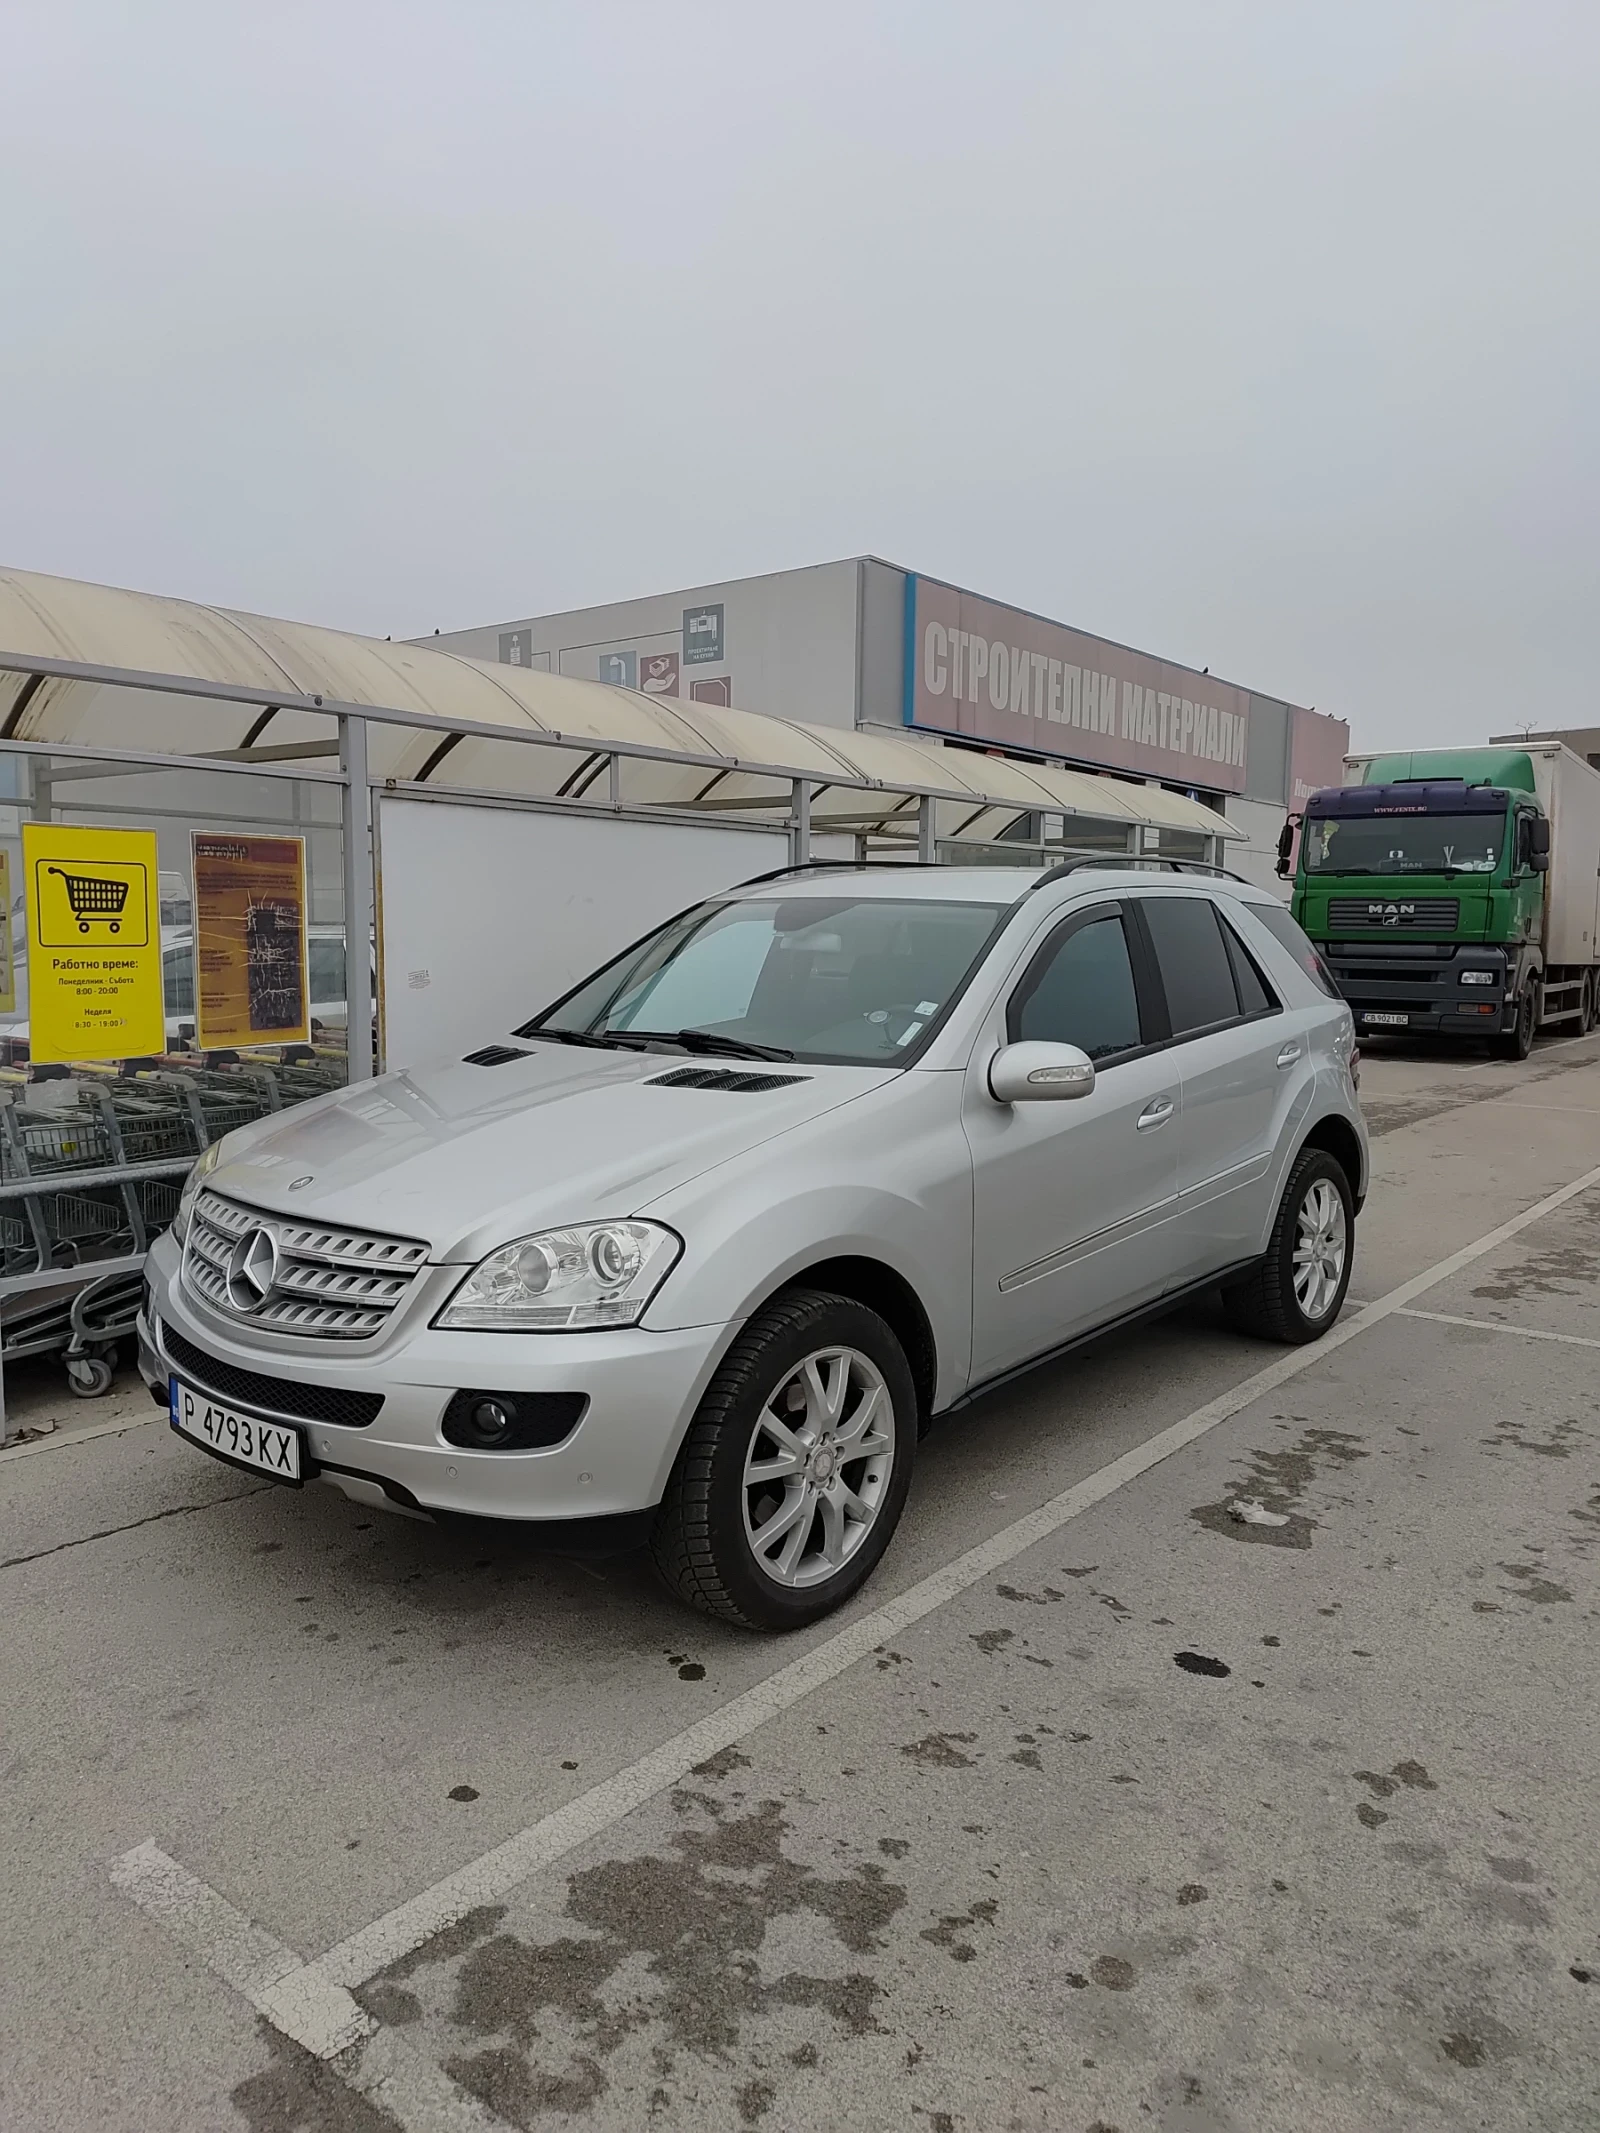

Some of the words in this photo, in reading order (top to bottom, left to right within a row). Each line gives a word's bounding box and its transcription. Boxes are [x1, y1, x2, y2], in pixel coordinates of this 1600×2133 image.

[924, 621, 1116, 737] СТРОИТЕЛНИ
[1121, 680, 1246, 768] МАТЕРИАЛИ
[1368, 904, 1415, 914] MAN
[52, 959, 100, 970] Работно
[102, 960, 139, 971] време:
[58, 978, 104, 986] Понеделник
[76, 987, 93, 996] 8:00
[97, 986, 119, 995] 20:00
[84, 1008, 112, 1017] Неделя
[203, 1406, 254, 1457] 4793
